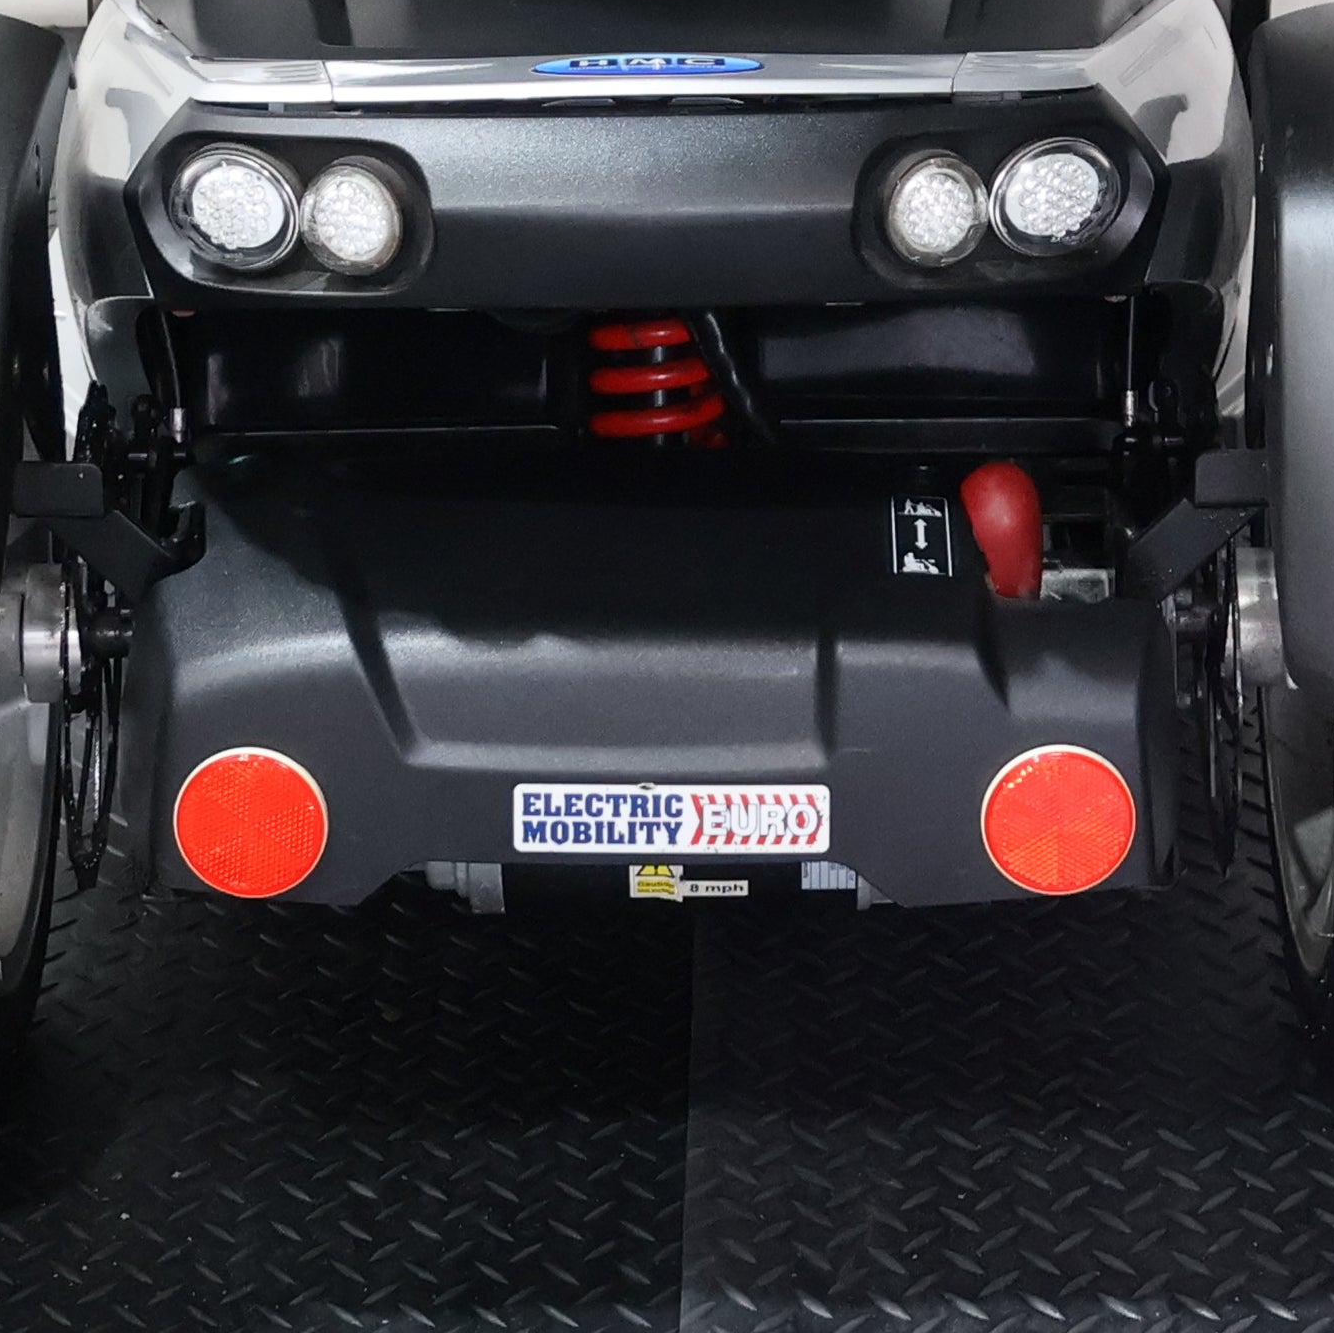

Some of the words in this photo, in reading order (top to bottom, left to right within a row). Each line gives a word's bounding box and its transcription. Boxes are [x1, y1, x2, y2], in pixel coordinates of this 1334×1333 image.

[522, 793, 683, 818] ELECTRIC
[702, 803, 818, 836] EURO
[522, 820, 683, 845] MOBILITY
[689, 883, 699, 893] 8
[705, 883, 744, 894] mph
